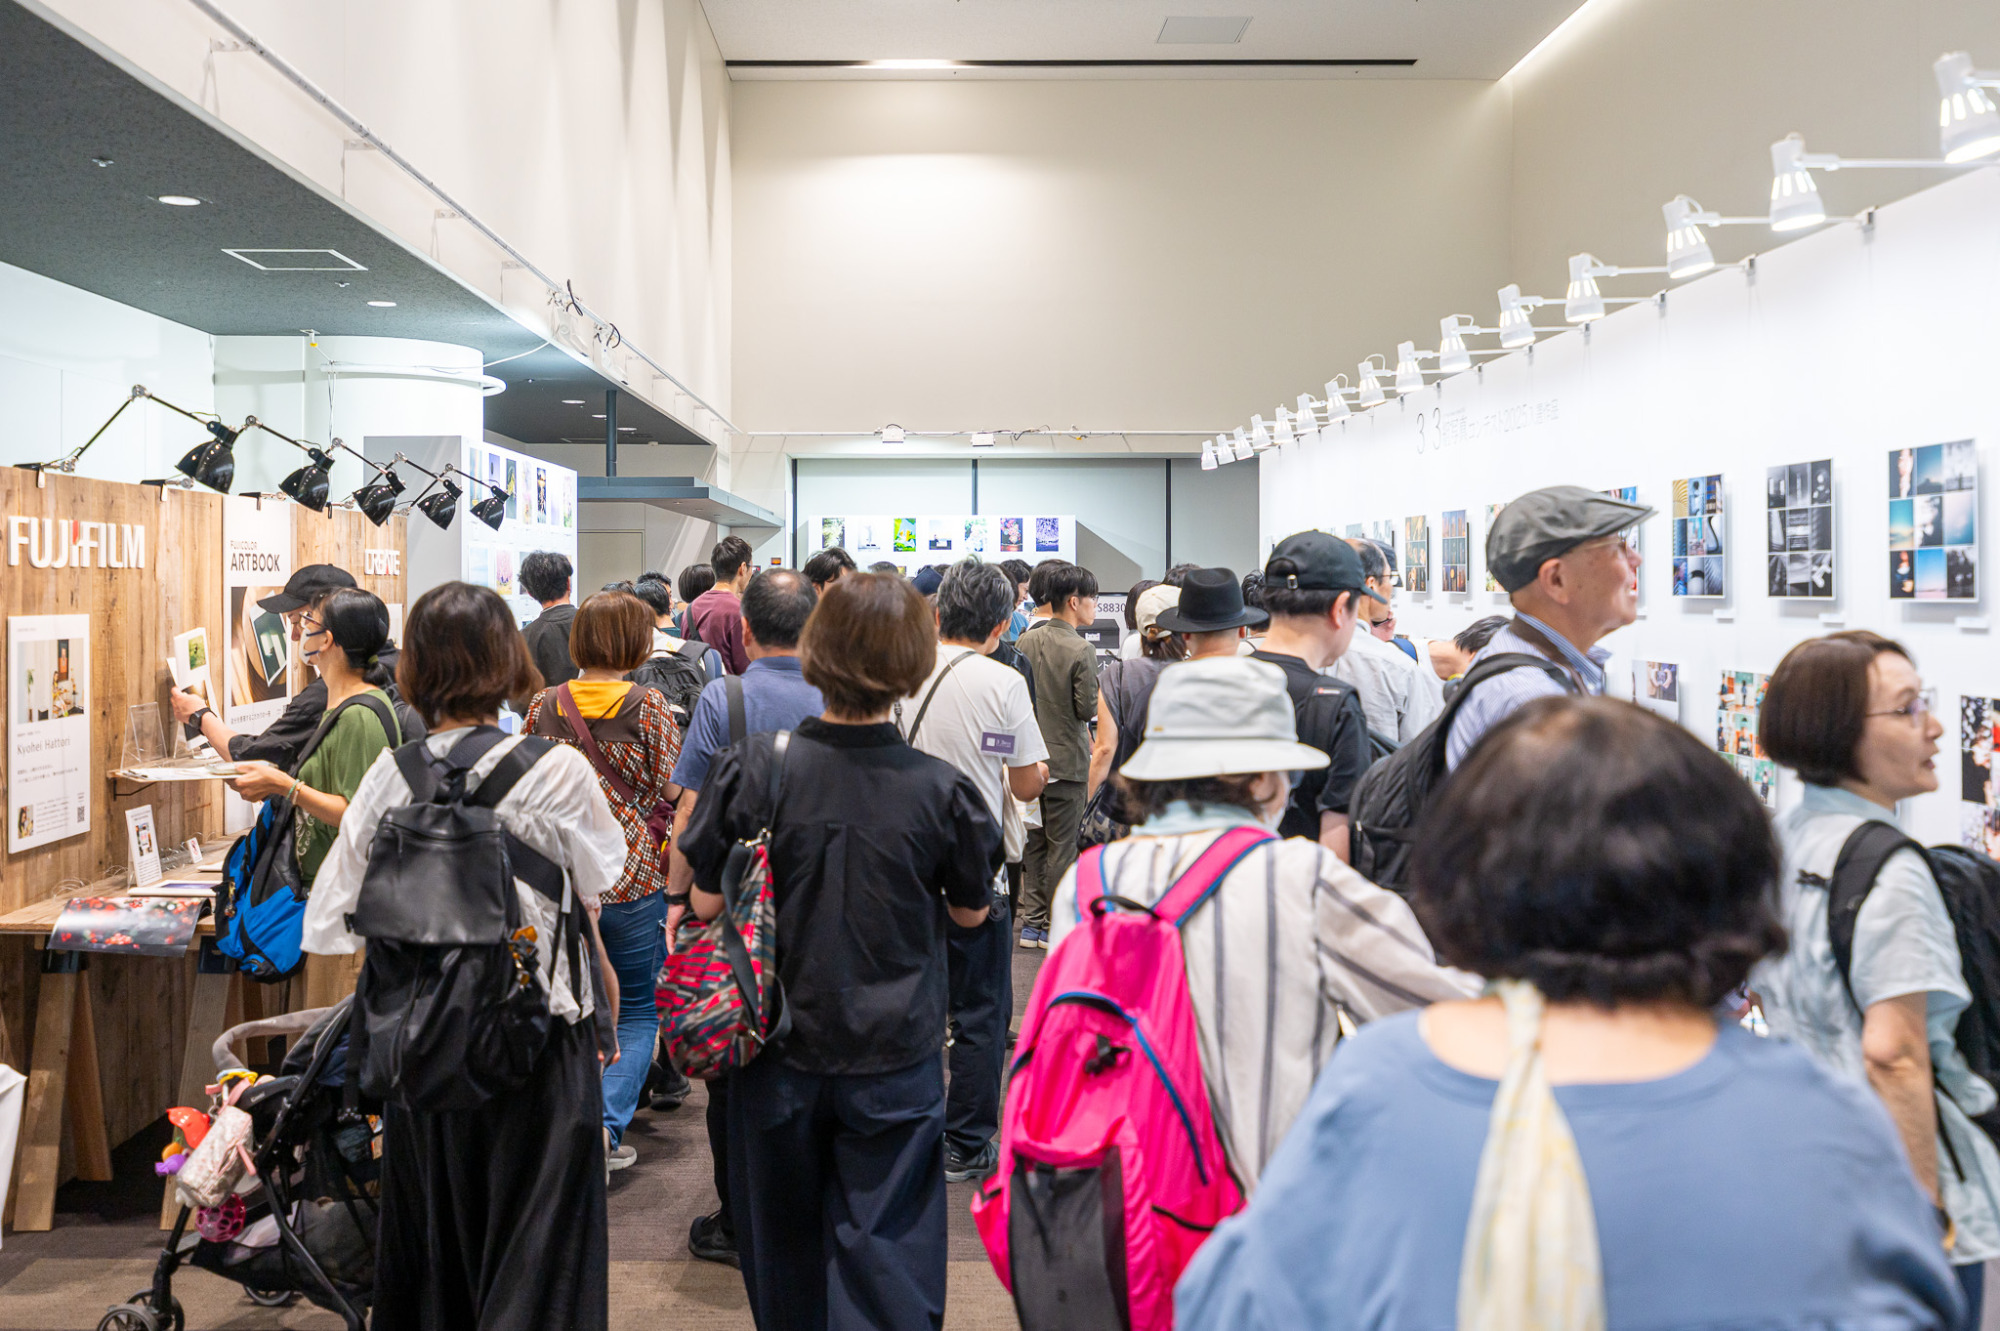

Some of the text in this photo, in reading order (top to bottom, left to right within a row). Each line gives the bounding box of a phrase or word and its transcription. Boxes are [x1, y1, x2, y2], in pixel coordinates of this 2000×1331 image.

[7, 515, 146, 569] FUJIFILM
[230, 552, 281, 572] ARTBOOK
[17, 741, 42, 757] Kyohei
